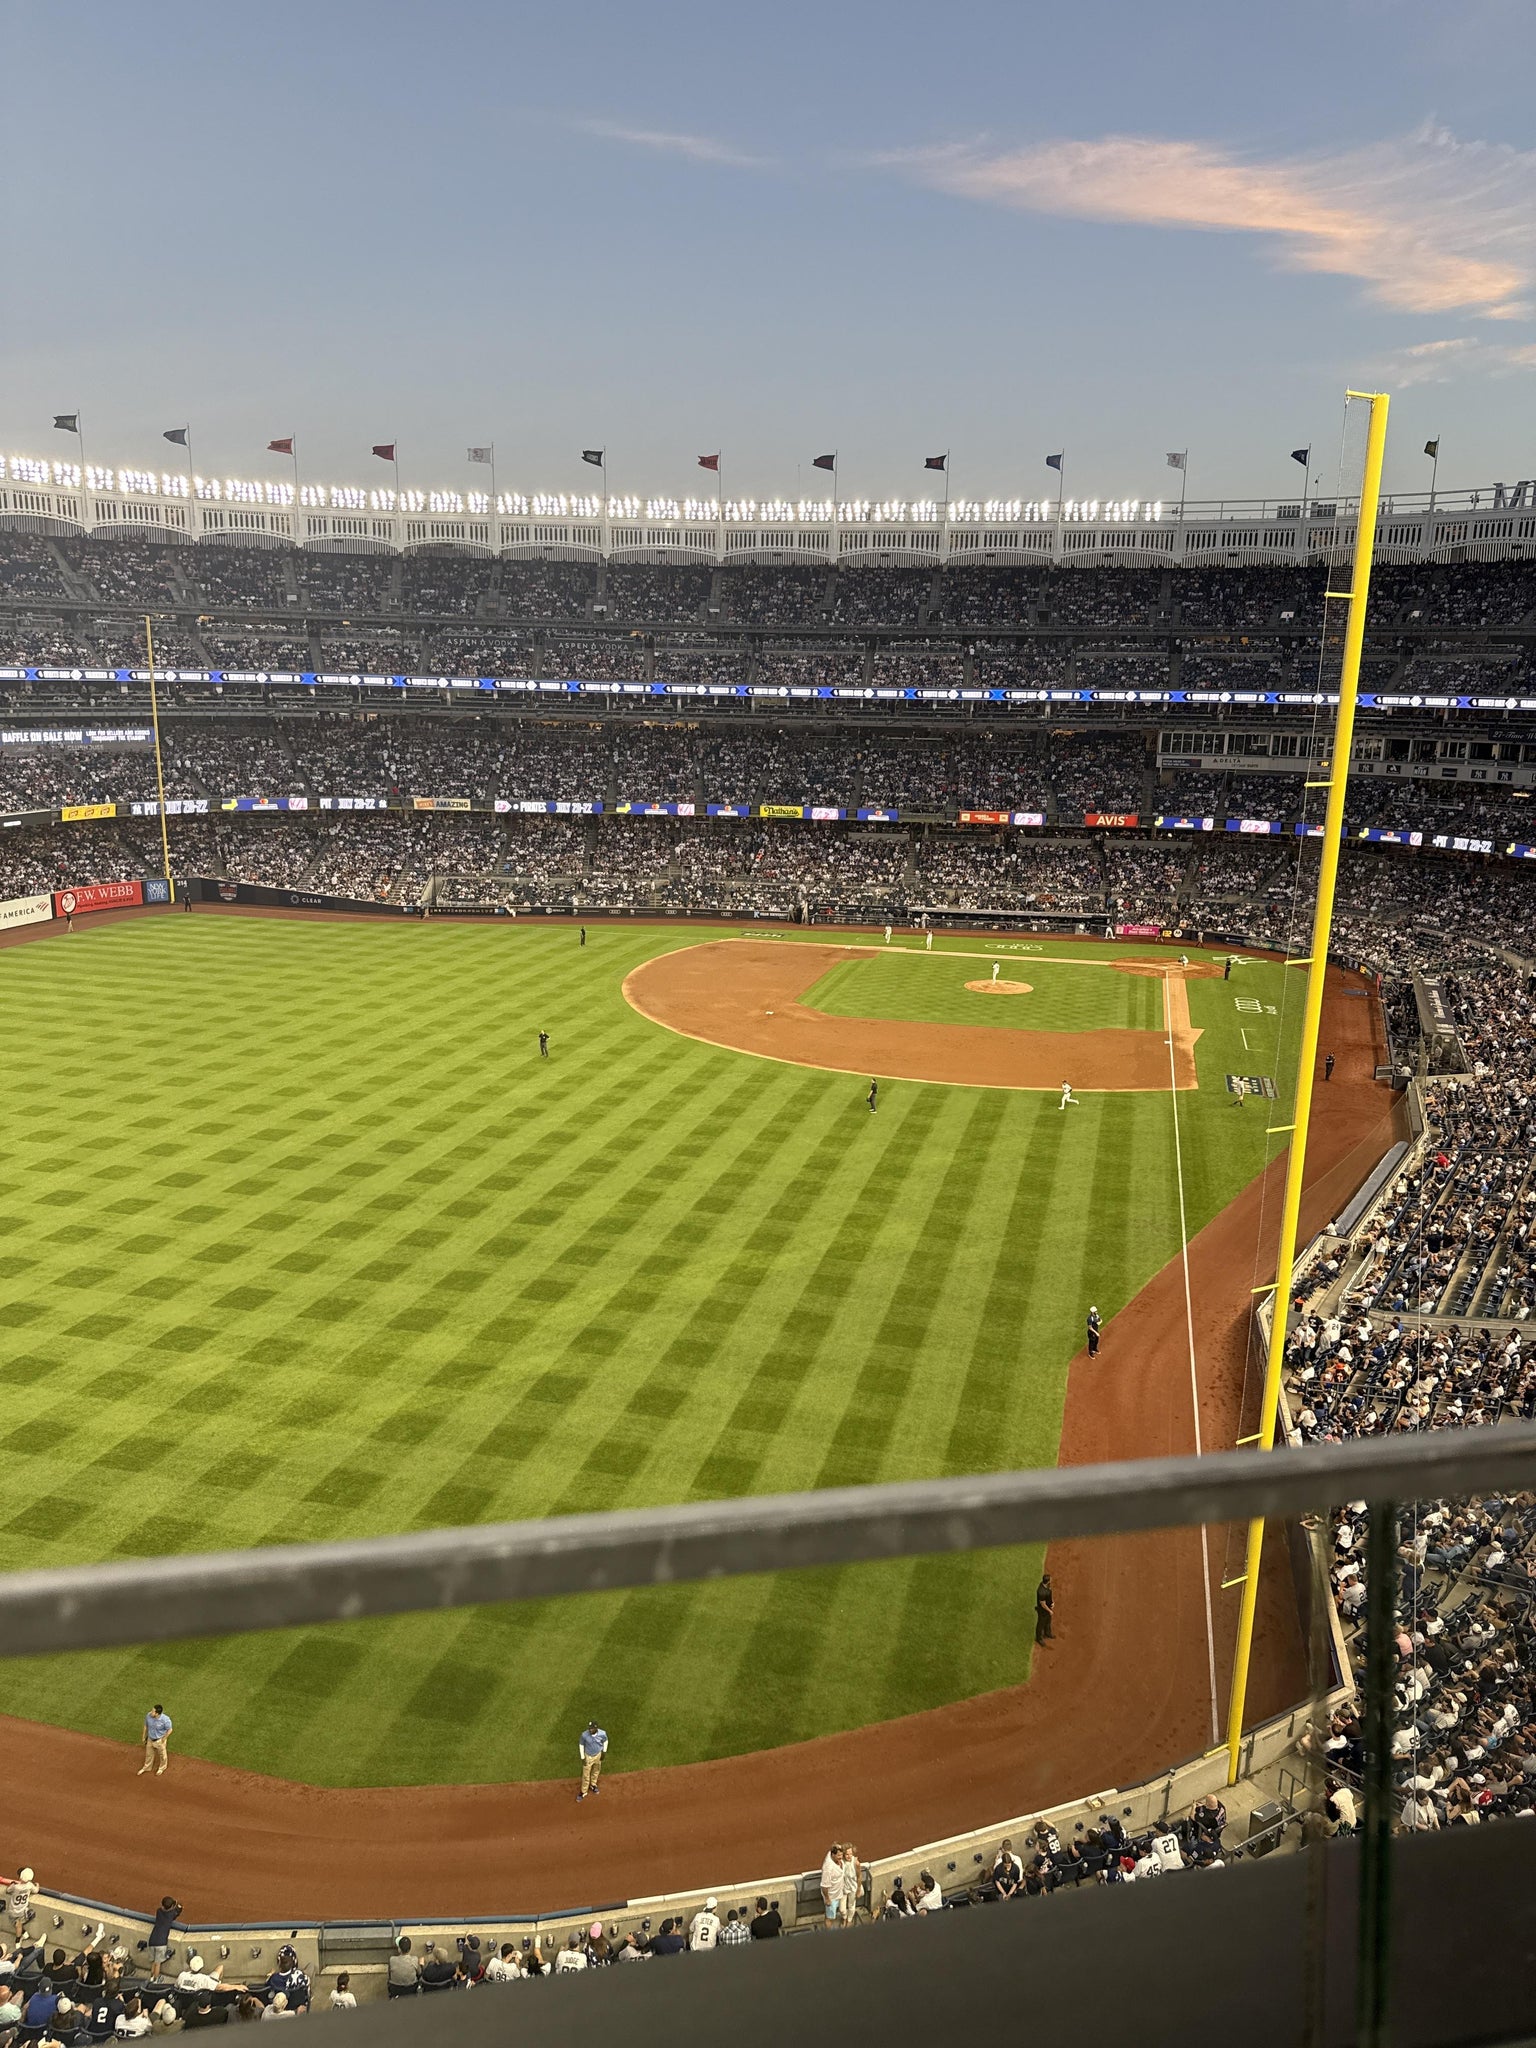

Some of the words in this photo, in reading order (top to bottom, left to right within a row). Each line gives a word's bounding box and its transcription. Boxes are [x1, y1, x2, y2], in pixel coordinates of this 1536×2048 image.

[447, 638, 477, 646] ASPEN
[488, 639, 519, 647] VODKA
[2, 731, 29, 742] RAFFLE
[43, 731, 63, 742] SALE
[764, 806, 799, 816] Nathan's
[1096, 815, 1125, 826] AVIS
[76, 889, 95, 902] F.W.
[98, 885, 134, 898] WEBB
[3, 908, 35, 919] AMERICA
[1048, 1839, 1061, 1854] 99
[1161, 1838, 1176, 1854] 27
[14, 1894, 28, 1906] 99
[700, 1927, 710, 1941] 2
[564, 1957, 579, 1966] JUDGE
[97, 2006, 108, 2023] 2
